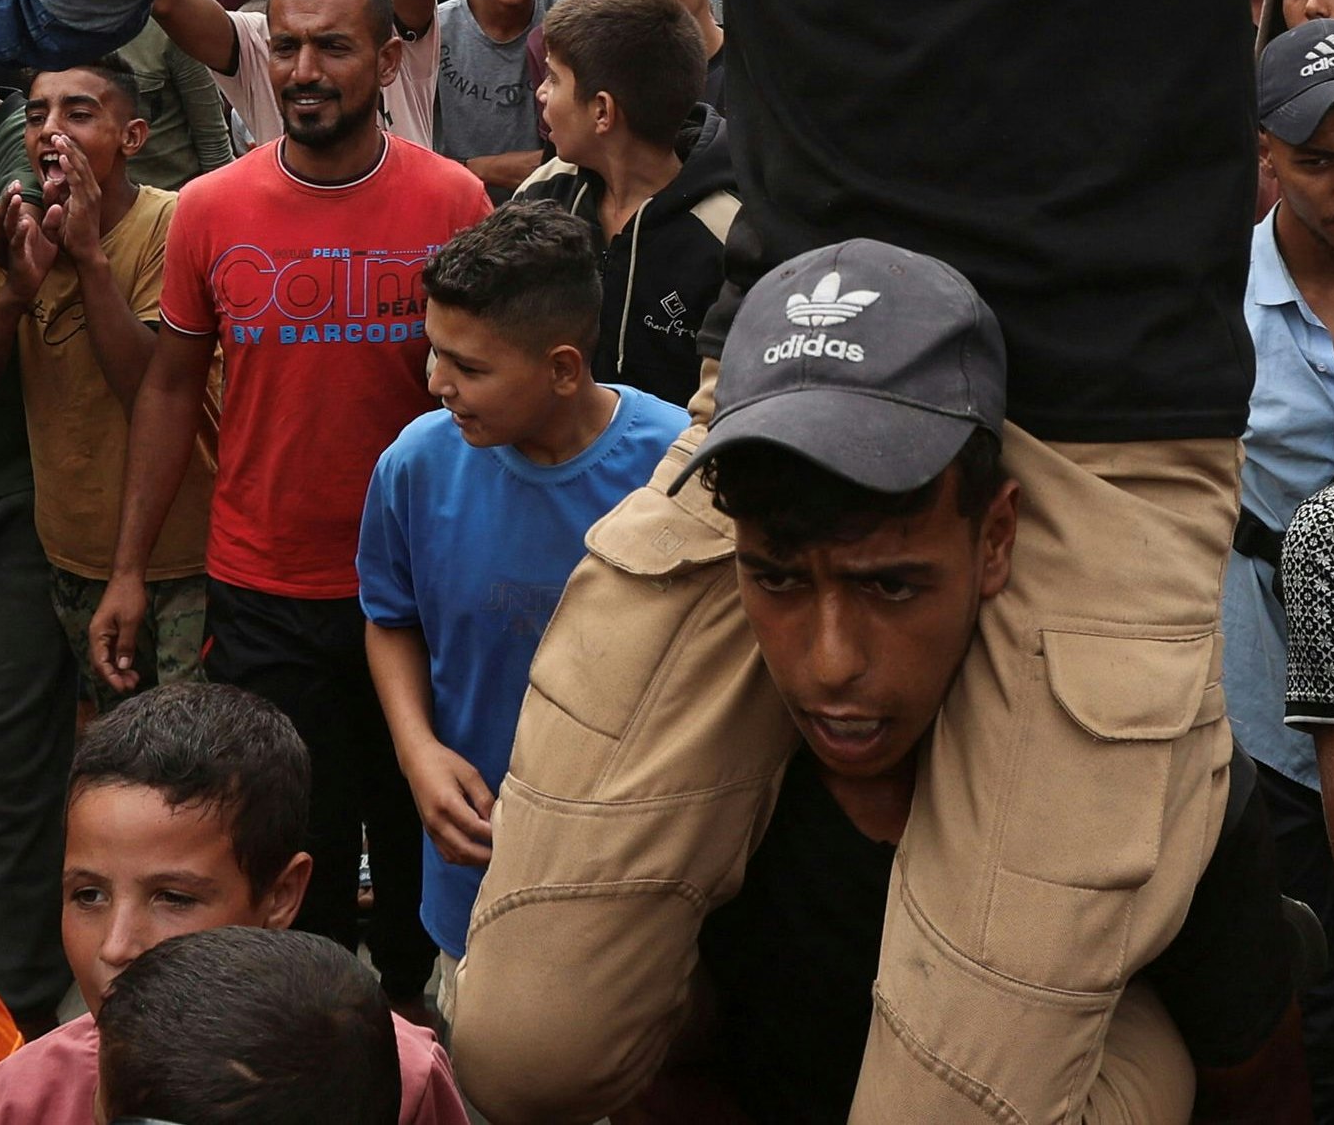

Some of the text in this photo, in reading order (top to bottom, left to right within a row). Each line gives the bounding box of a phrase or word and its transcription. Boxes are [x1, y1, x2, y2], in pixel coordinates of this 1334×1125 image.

[440, 44, 492, 102] CHANAL
[312, 248, 350, 258] PEAR
[232, 320, 425, 345] BY BARCODE
[763, 333, 865, 364] adidas
